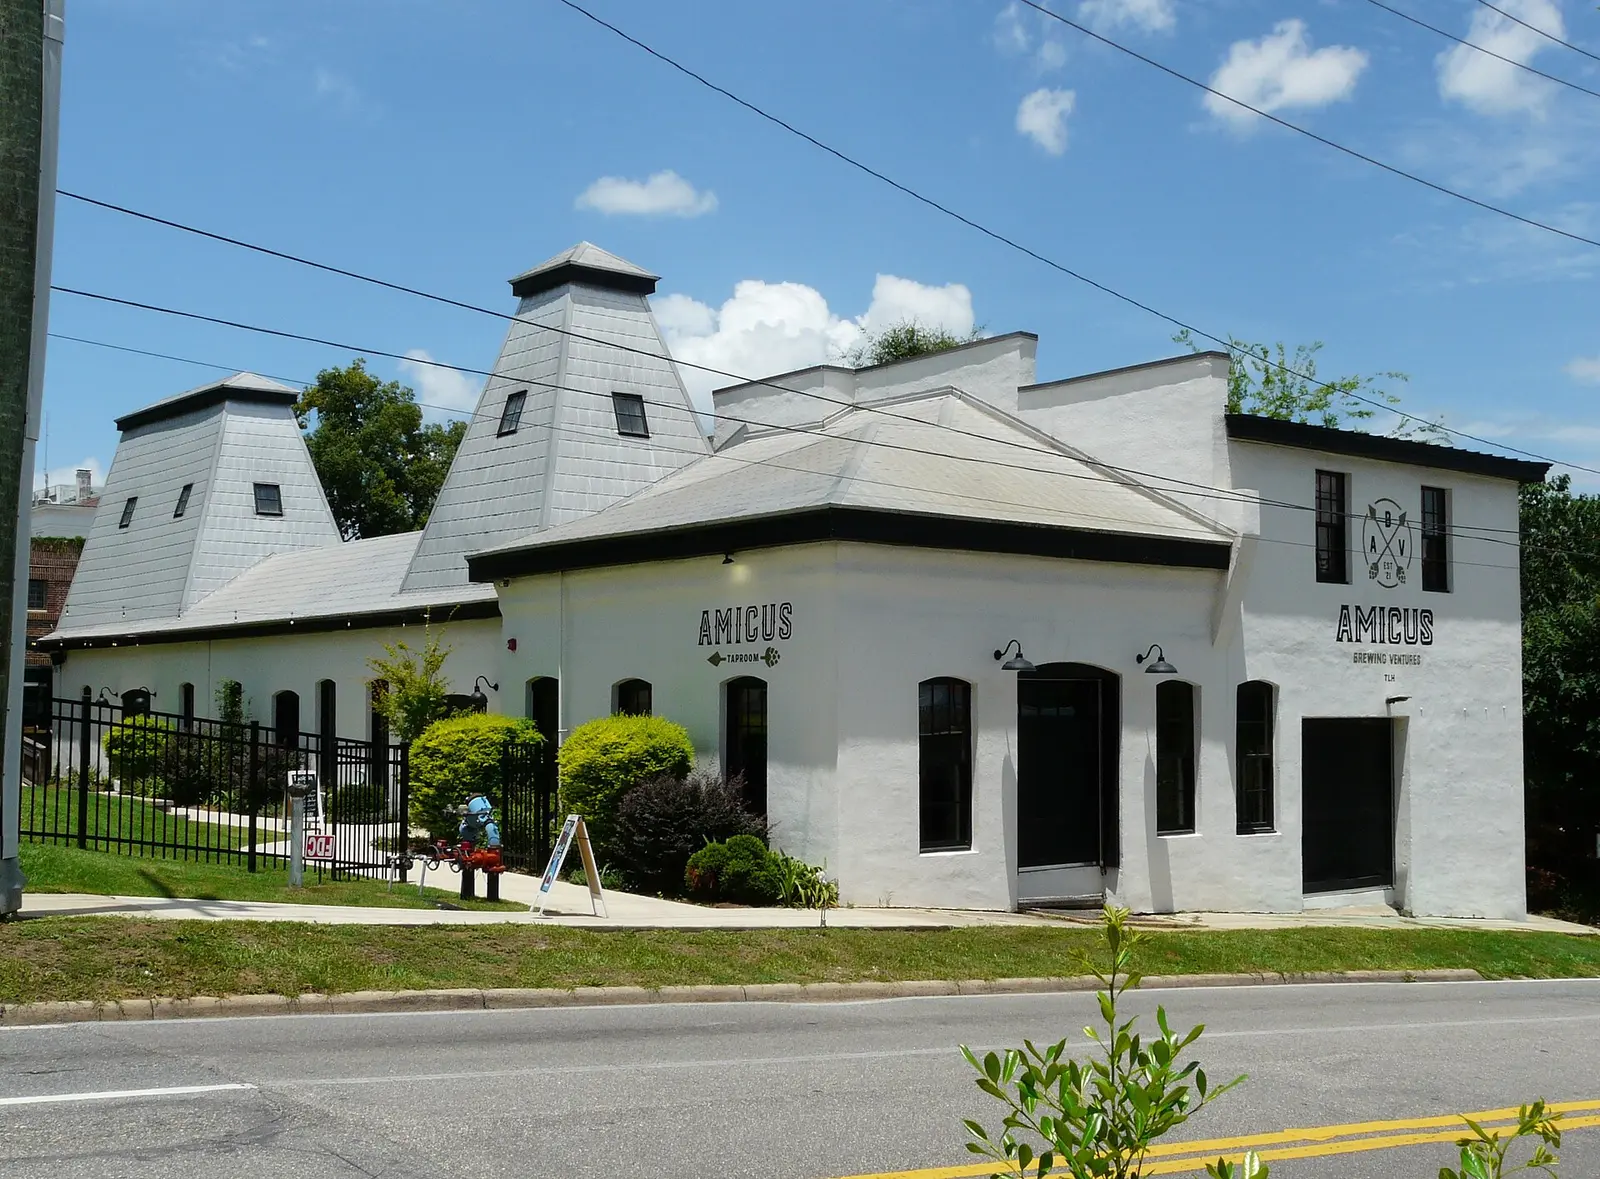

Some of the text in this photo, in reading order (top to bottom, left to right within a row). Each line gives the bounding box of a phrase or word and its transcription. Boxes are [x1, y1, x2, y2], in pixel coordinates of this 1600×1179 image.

[1384, 511, 1391, 528] B
[1370, 536, 1377, 553] A
[1398, 539, 1405, 556] V
[1383, 562, 1393, 570] EST
[698, 602, 792, 645] AMICUS
[1336, 605, 1433, 645] AMICUS
[727, 653, 759, 663] TAPROOM
[1353, 652, 1421, 666] BREWING VENTURES
[1384, 674, 1395, 682] TLH
[307, 836, 333, 857] FDC
